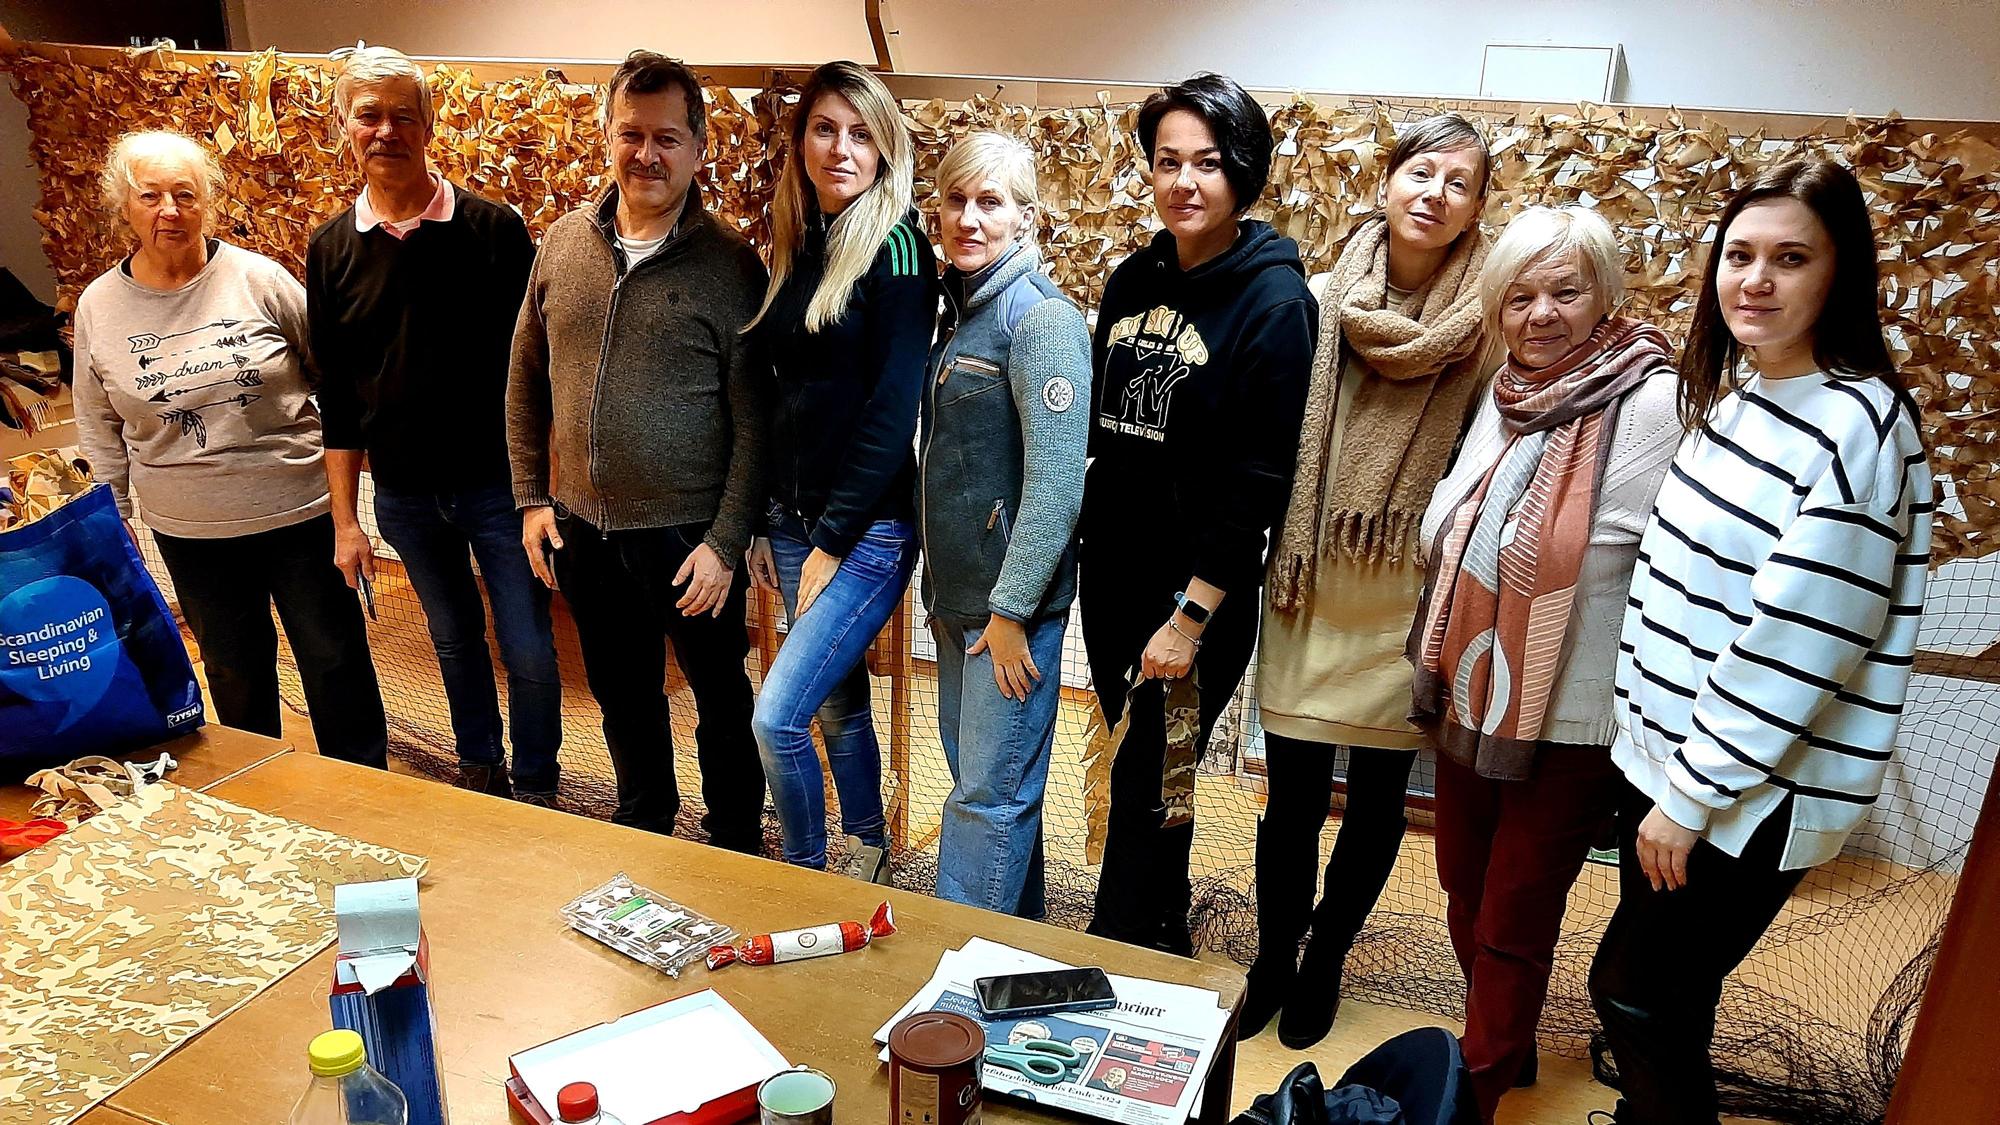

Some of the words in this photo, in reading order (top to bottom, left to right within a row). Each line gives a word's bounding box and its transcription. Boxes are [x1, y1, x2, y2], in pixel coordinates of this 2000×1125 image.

[174, 361, 224, 377] dream
[1119, 421, 1165, 443] TELEVISION
[8, 637, 86, 665] Sleeping
[88, 628, 99, 643] &
[38, 655, 91, 680] Living
[175, 706, 200, 722] JYSK
[1068, 1087, 1095, 1099] Ende
[1096, 1094, 1122, 1105] 2024
